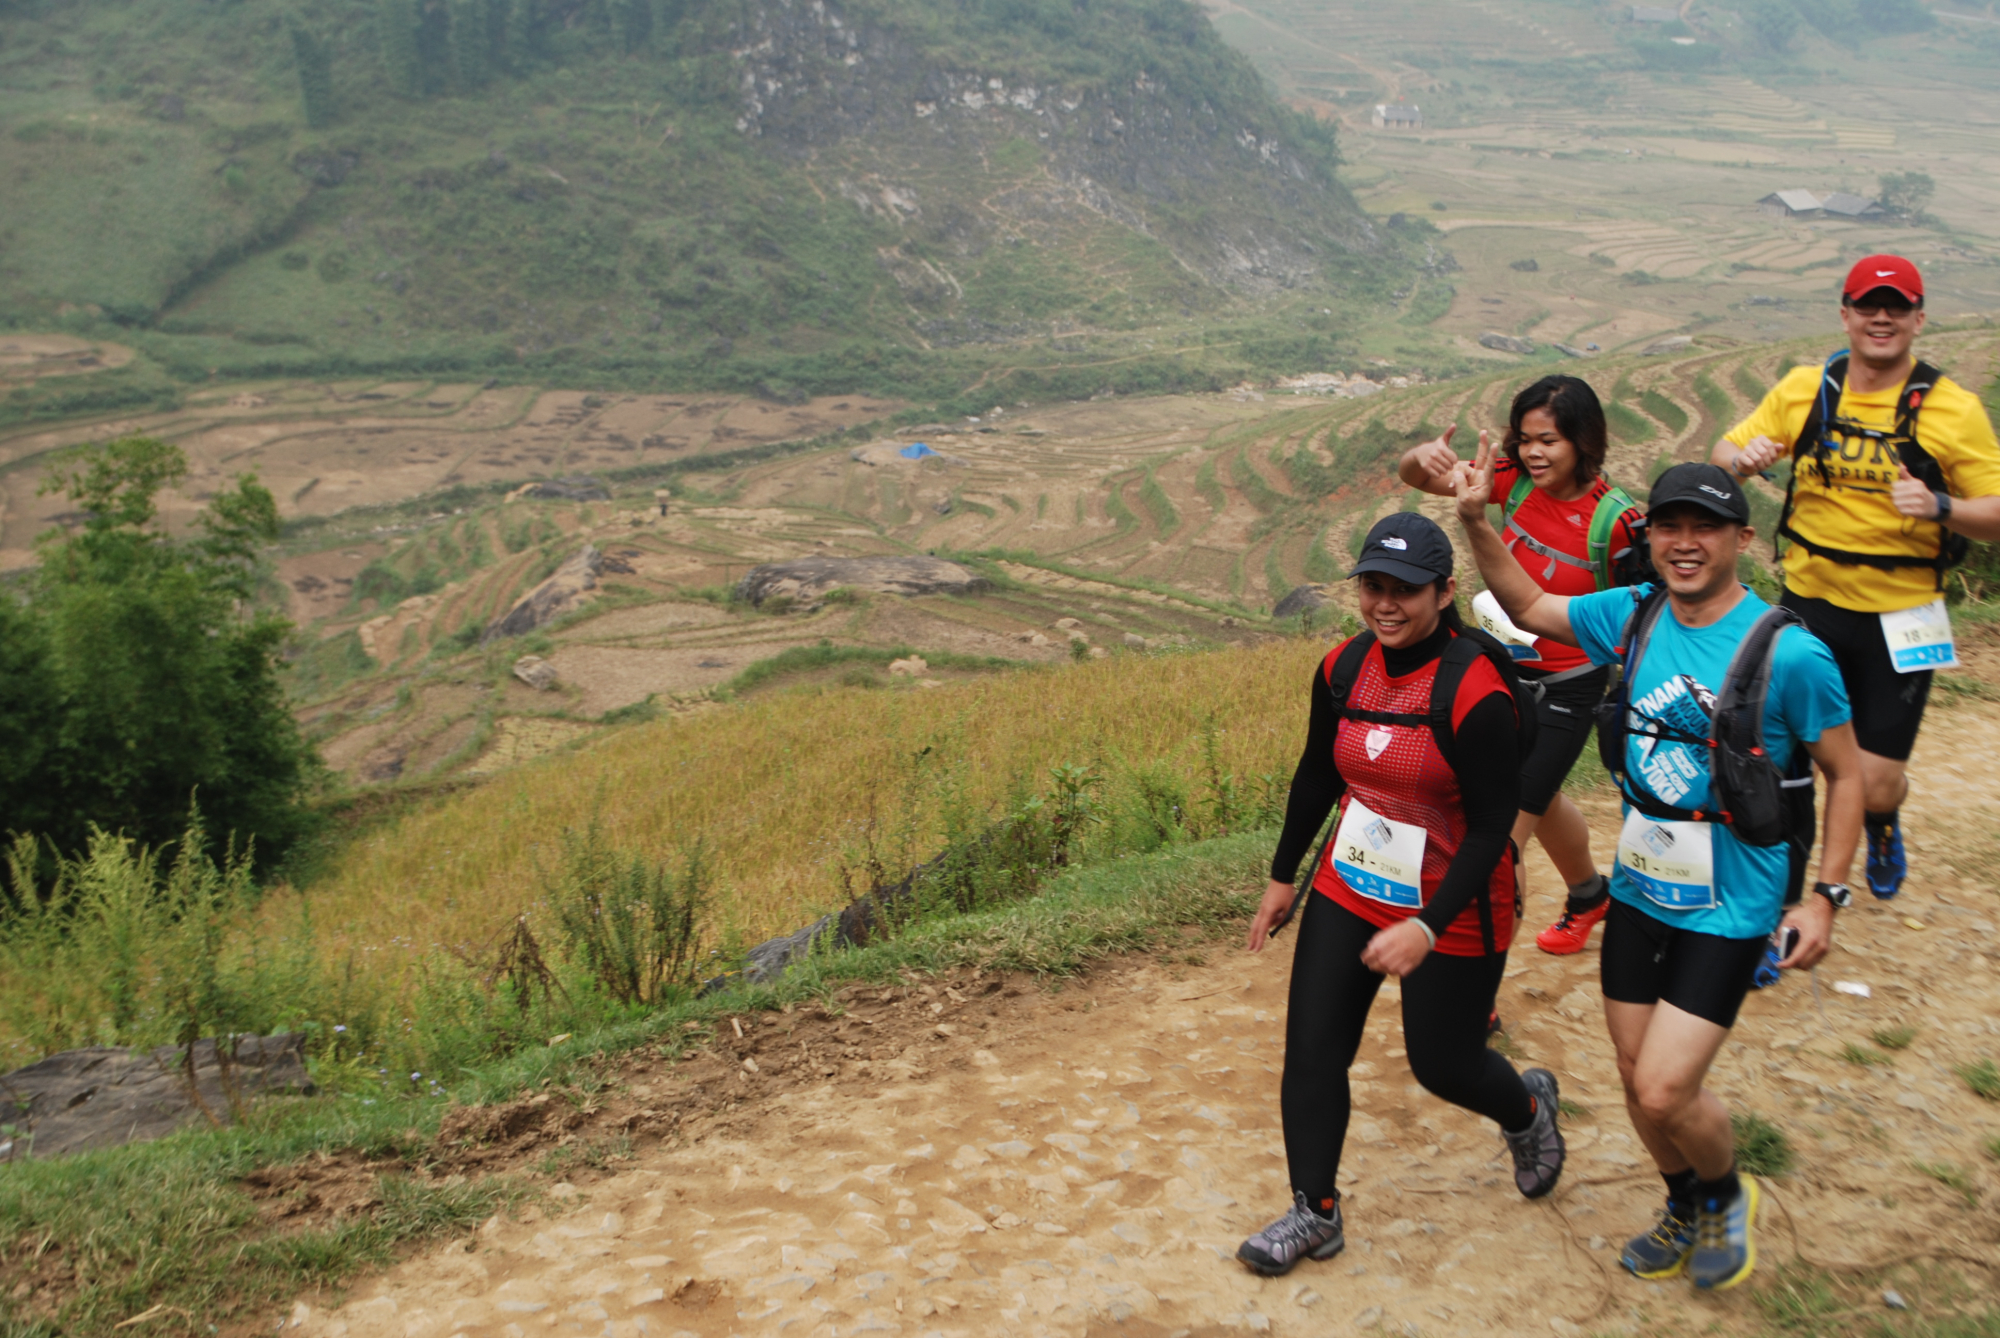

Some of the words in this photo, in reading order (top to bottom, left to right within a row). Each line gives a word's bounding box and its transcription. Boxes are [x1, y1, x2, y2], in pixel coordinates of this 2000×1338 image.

[1800, 462, 1901, 484] INSPIRE
[1482, 615, 1494, 632] 35
[1903, 628, 1922, 644] 18
[1676, 695, 1711, 738] MOUN
[1643, 758, 1683, 806] 70KM
[1347, 845, 1365, 866] 34
[1380, 862, 1402, 877] 21KM
[1631, 852, 1647, 872] 31
